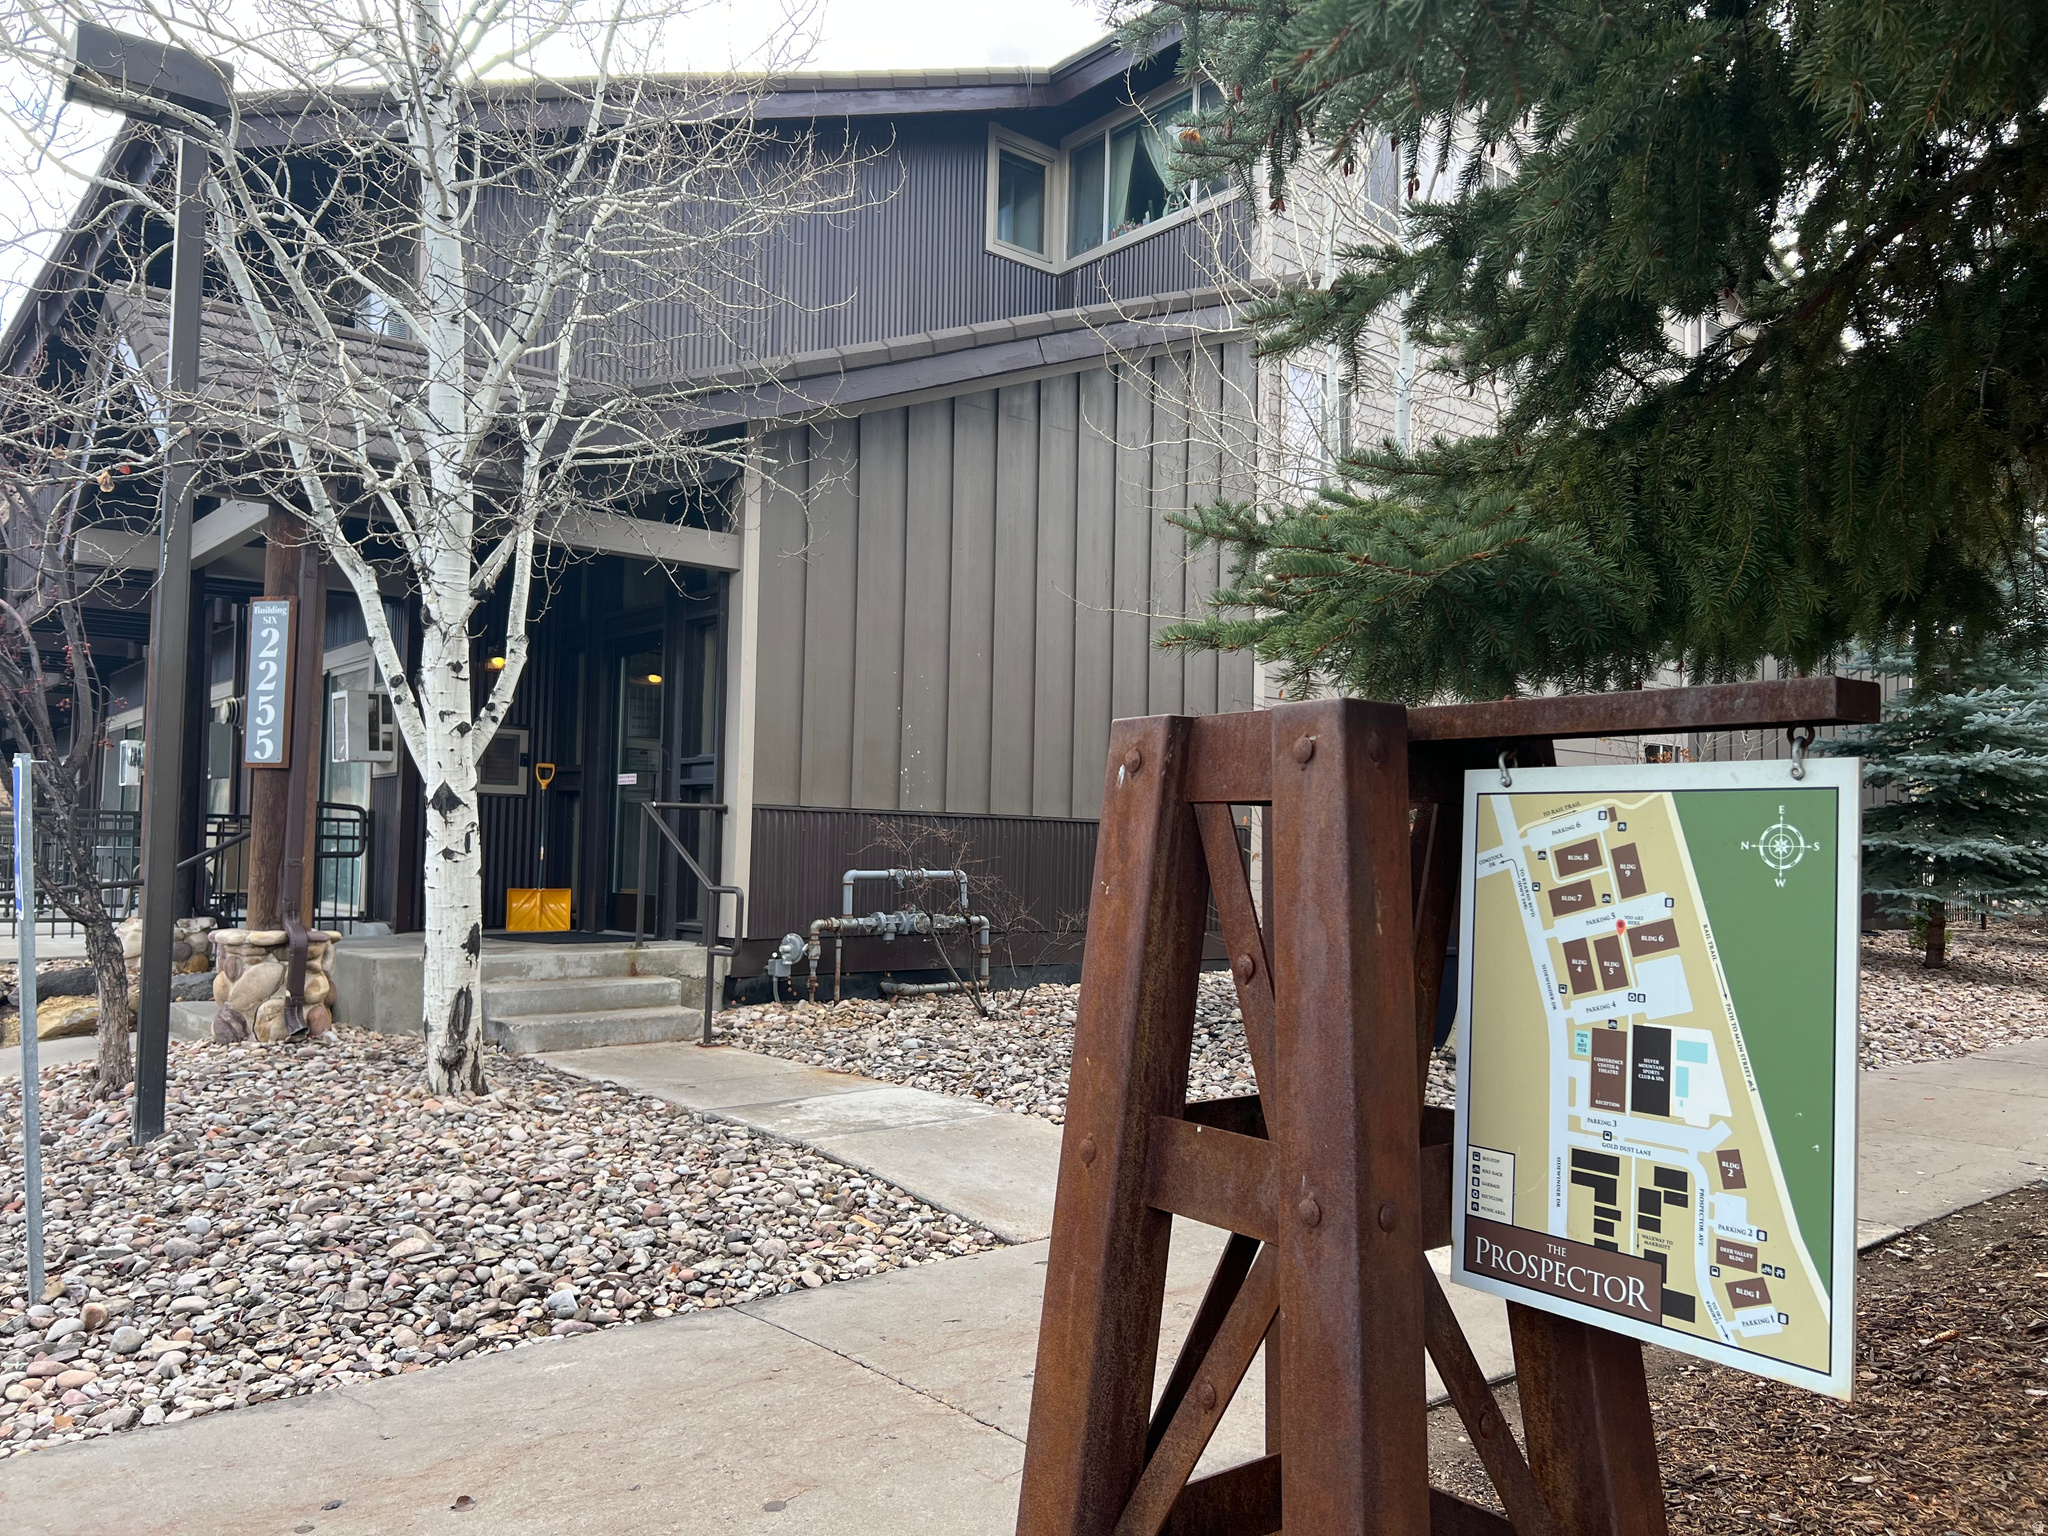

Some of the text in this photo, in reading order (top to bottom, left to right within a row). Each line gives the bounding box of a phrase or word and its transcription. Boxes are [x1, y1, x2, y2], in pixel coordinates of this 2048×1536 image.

[254, 605, 287, 616] Building
[262, 616, 278, 624] SIX
[254, 628, 280, 760] 2255
[1564, 802, 1581, 810] TRAIL
[1778, 805, 1785, 814] E
[1552, 825, 1575, 835] PARKING
[1740, 841, 1749, 850] N
[1813, 842, 1820, 851] S
[1479, 853, 1504, 866] COMSTOCK
[1520, 868, 1524, 877] TO
[1522, 879, 1531, 899] KEARNS
[1774, 878, 1786, 888] W
[1586, 916, 1610, 925] PARKING
[1703, 924, 1718, 962] RAIL TRAIL
[1542, 964, 1557, 1010] SIDEWINDER DR
[1586, 1004, 1610, 1013] PARKING
[1726, 1003, 1751, 1078] PATH TO MAIN STREET
[1594, 1057, 1624, 1066] CONFERENCE
[1595, 1100, 1620, 1108] RECEPTION
[1587, 1118, 1612, 1127] PARKING
[1636, 1148, 1652, 1156] LANE
[1722, 1161, 1740, 1170] BLDG
[1727, 1169, 1734, 1177] 2
[1556, 1198, 1560, 1208] DR
[1718, 1224, 1752, 1237] PARKING 2
[1642, 1234, 1665, 1243] WALKWAY
[1546, 1243, 1567, 1257] THE
[1644, 1240, 1671, 1250] MARRIOTT
[1734, 1250, 1753, 1259] VALLEY
[1475, 1236, 1652, 1312] PROSPECTOR
[1736, 1287, 1760, 1299] BLDG 1
[1712, 1302, 1718, 1310] TO
[1705, 1301, 1719, 1325] RESORTS
[1742, 1315, 1775, 1327] PARKING 1
